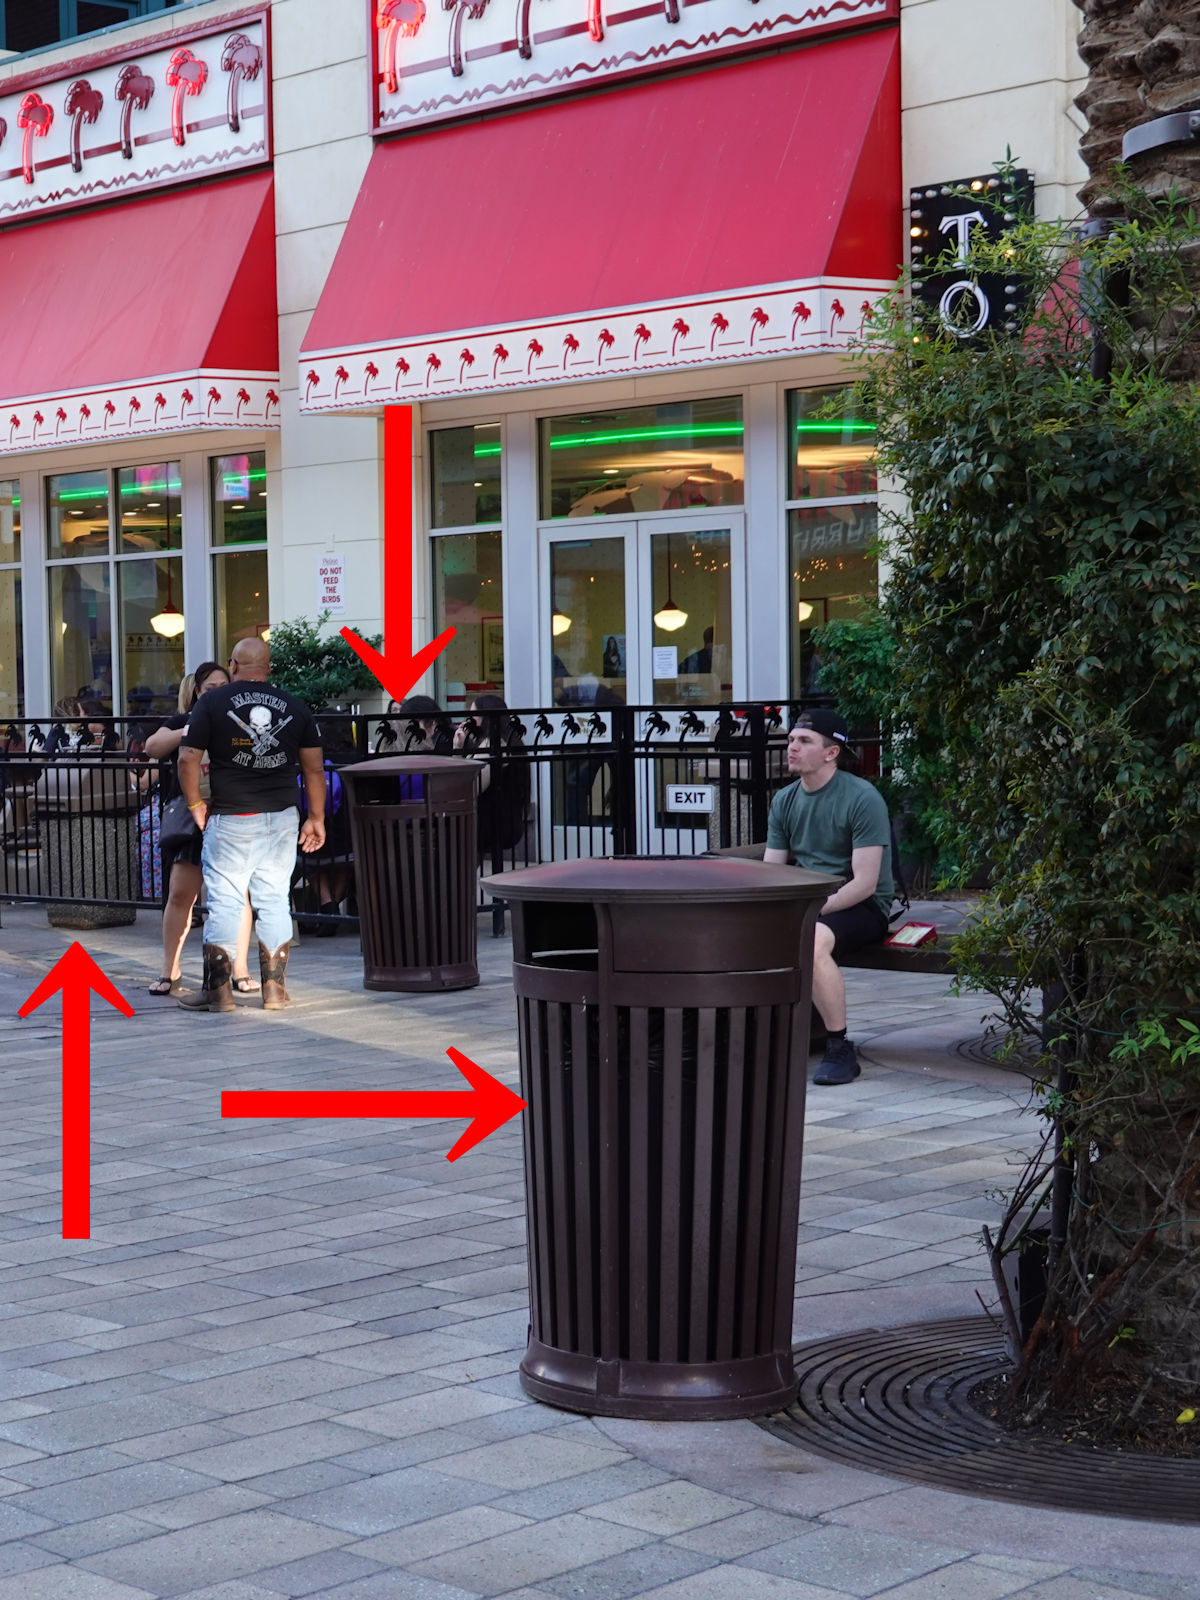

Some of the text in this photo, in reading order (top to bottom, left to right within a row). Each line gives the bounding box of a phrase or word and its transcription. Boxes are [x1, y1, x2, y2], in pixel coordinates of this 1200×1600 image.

[319, 567, 342, 576] DO NOT
[323, 577, 339, 585] FEED
[325, 586, 337, 594] THE
[322, 595, 341, 604] BIRDS
[230, 691, 288, 713] MASTER
[232, 751, 288, 769] AT ARMS
[675, 792, 706, 804] EXIT
